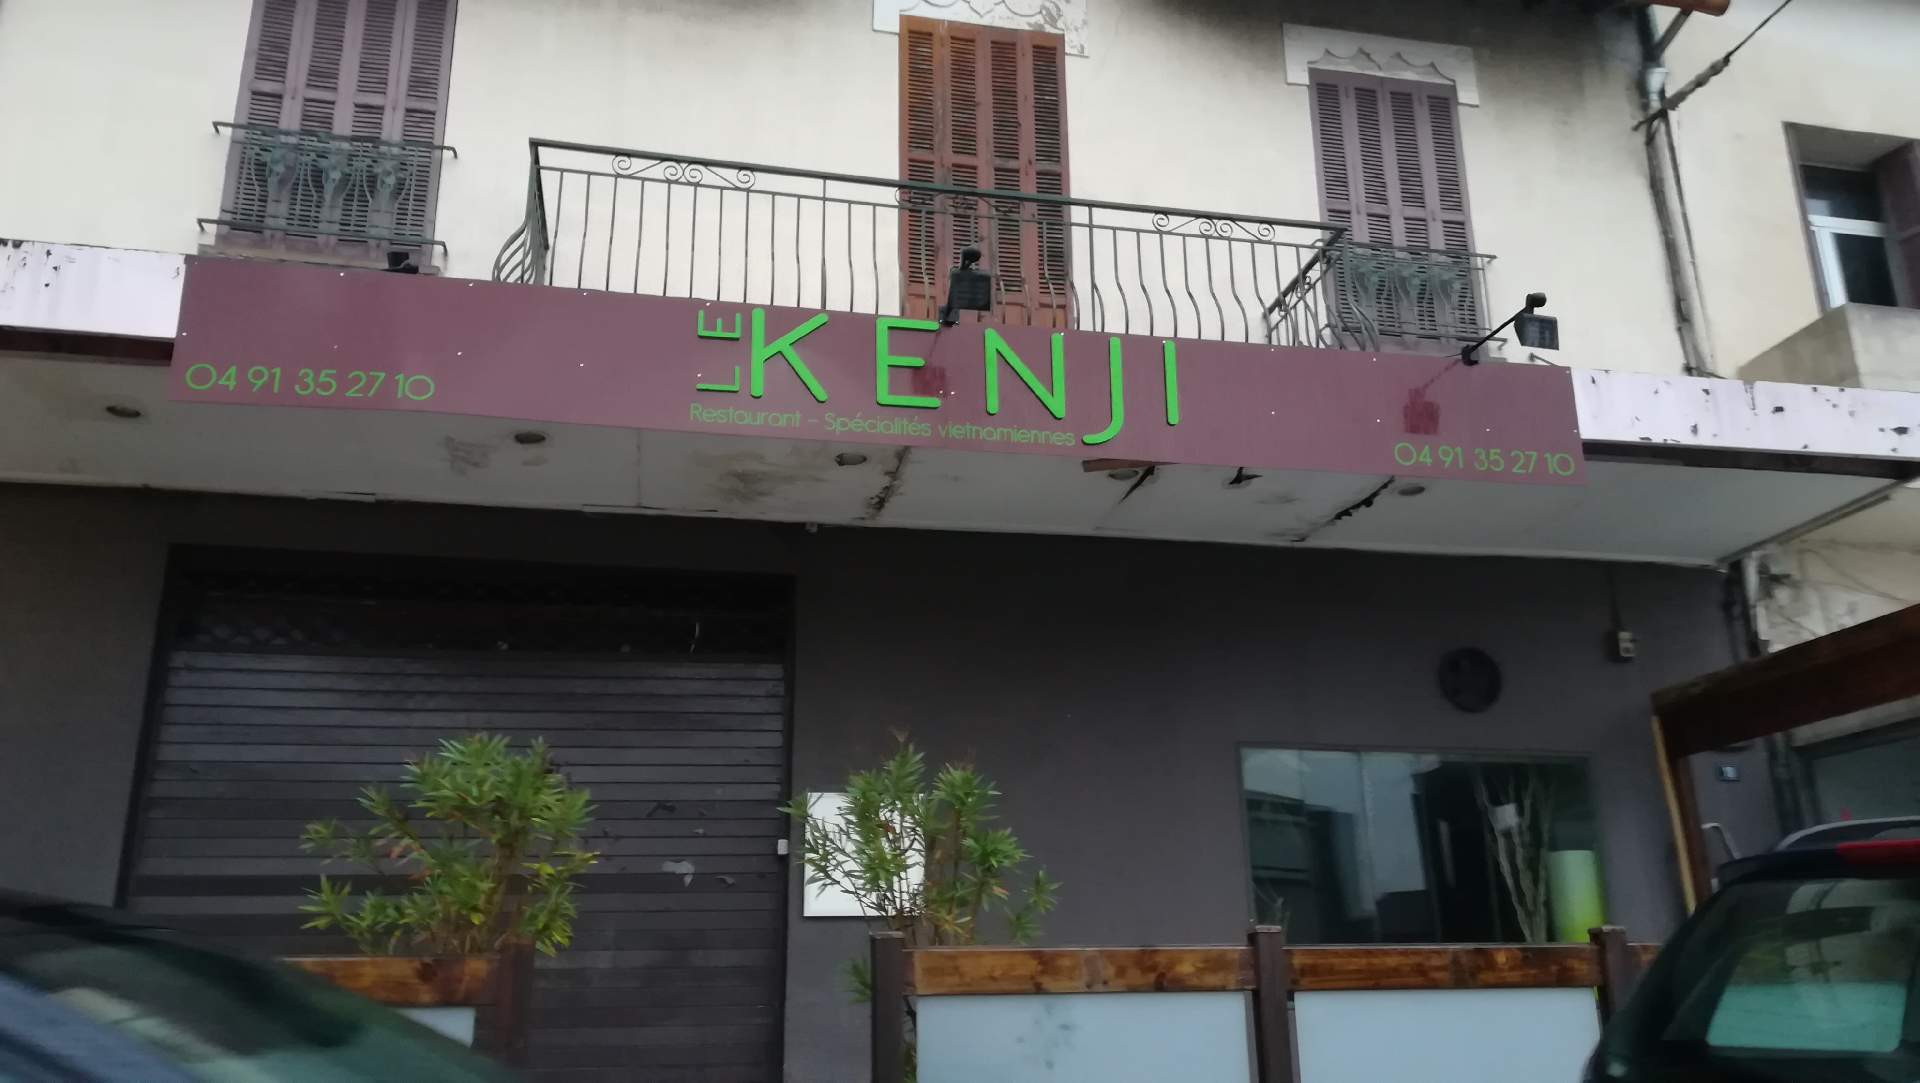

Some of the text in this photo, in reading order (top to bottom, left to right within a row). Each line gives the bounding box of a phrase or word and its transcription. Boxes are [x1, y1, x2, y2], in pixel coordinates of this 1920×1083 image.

[696, 310, 741, 392] LE
[184, 363, 436, 401] 04 91 35 27 10
[750, 308, 1179, 445] KENJI
[689, 403, 801, 428] Restaurant
[824, 411, 933, 437] Spécialités
[937, 420, 1076, 446] vietnamiennes
[1394, 442, 1576, 477] 04 91 35 27 10
